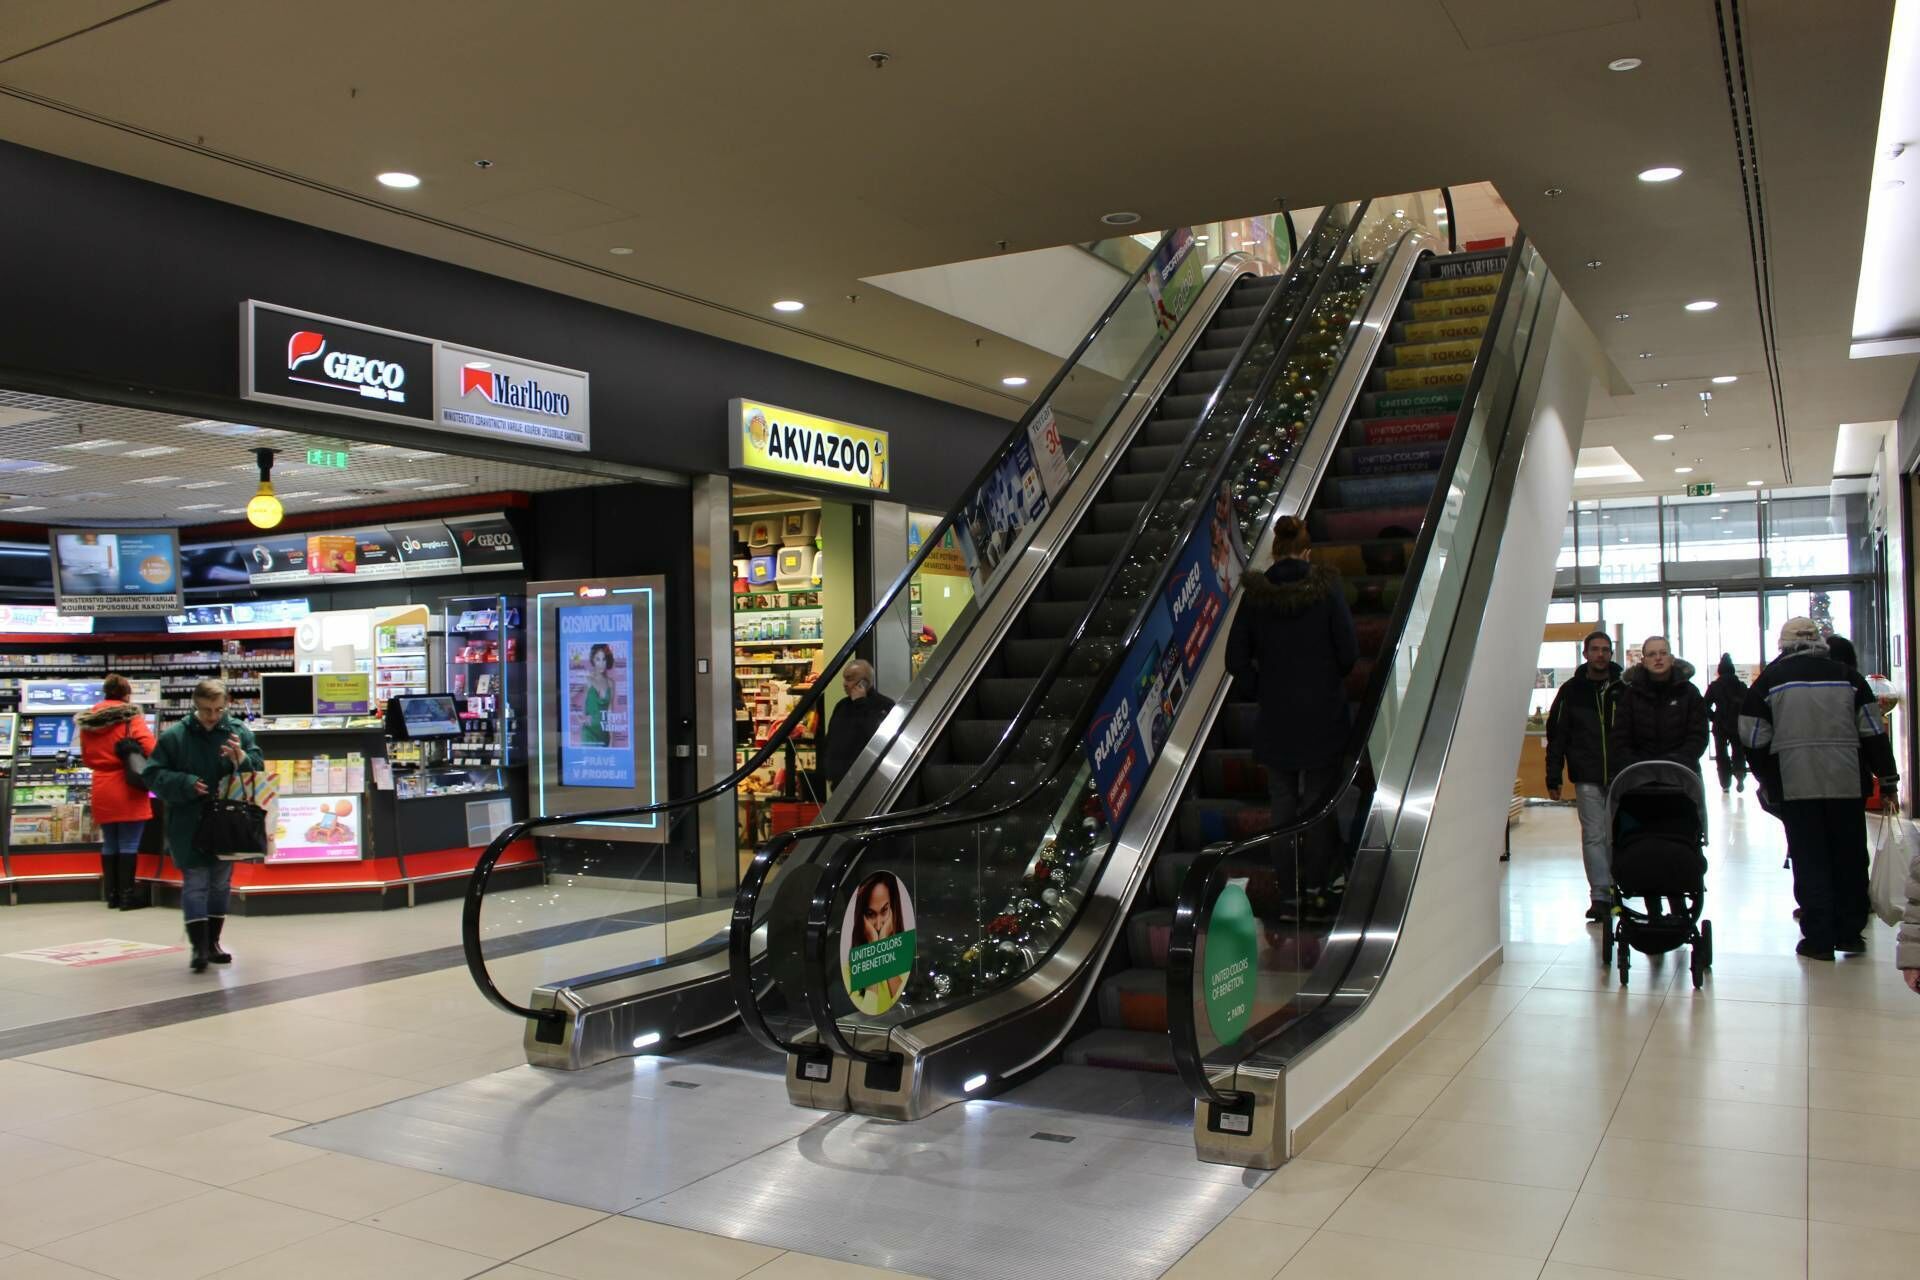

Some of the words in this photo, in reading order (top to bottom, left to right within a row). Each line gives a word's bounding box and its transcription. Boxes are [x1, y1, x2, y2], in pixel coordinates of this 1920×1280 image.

[1440, 263, 1463, 278] JOHN
[1455, 284, 1493, 295] TOKKO
[1448, 305, 1486, 316] TOKKO
[1439, 325, 1479, 337] TOKKO
[1431, 349, 1472, 361] TOKKO
[323, 351, 405, 389] GECO
[1422, 373, 1464, 386] TOKKO
[494, 373, 570, 416] Marlboro
[768, 423, 870, 475] AKVAZOO
[478, 533, 511, 547] GECO
[1172, 560, 1201, 622] PLANEO
[561, 612, 633, 634] COSMOPOLITAN
[1094, 697, 1129, 771] PLANEO
[851, 946, 876, 962] UNITED
[876, 936, 903, 954] COLORS
[851, 963, 861, 975] OF
[1212, 968, 1228, 986] UNITED
[1228, 957, 1249, 976] COLORS
[1212, 987, 1220, 1001] OF
